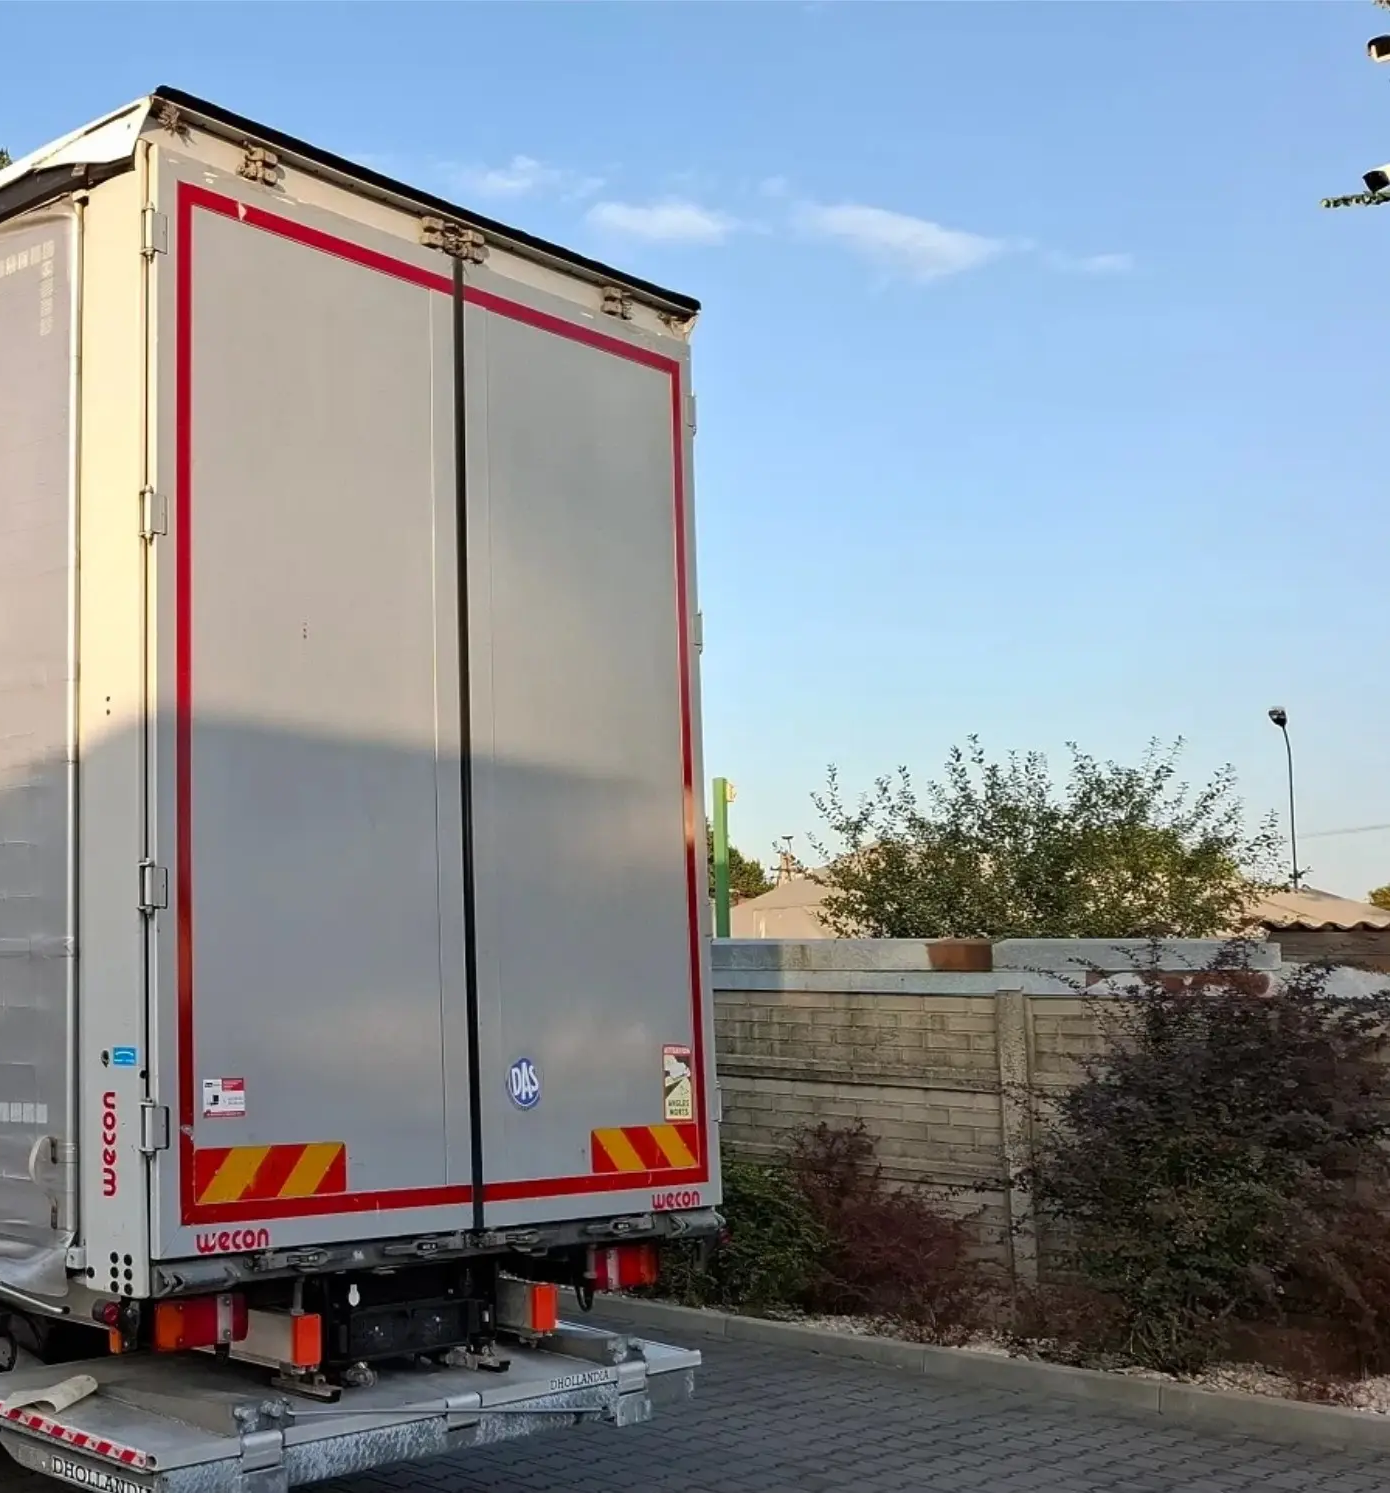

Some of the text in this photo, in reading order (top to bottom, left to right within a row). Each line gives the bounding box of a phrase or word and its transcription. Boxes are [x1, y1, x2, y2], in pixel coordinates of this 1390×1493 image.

[511, 1061, 539, 1101] DAS
[103, 1091, 116, 1197] wecon
[651, 1190, 700, 1209] wecon
[196, 1228, 269, 1253] wecon
[550, 1370, 609, 1391] DHOLLANDIA
[51, 1456, 154, 1493] DHOLLAND
